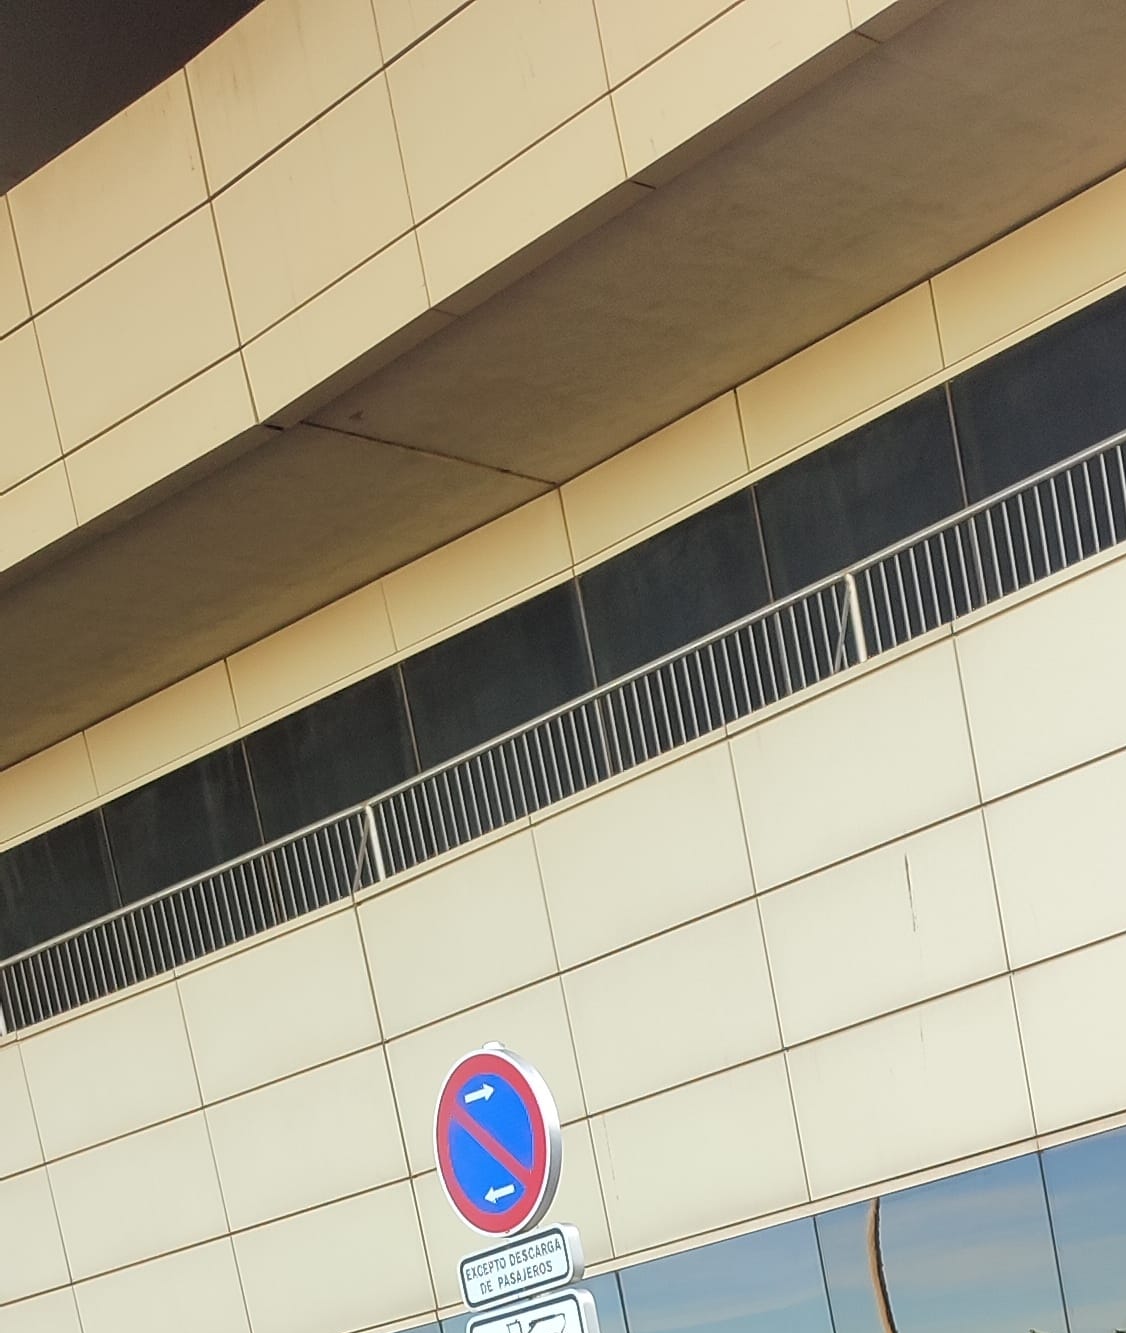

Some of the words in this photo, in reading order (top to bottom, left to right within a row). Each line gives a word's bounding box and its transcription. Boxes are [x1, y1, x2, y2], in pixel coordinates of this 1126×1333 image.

[465, 1256, 507, 1281] EXCEPTO
[508, 1238, 562, 1265] DESCARGA
[480, 1278, 493, 1295] DE
[498, 1260, 553, 1290] PASAJEROS
